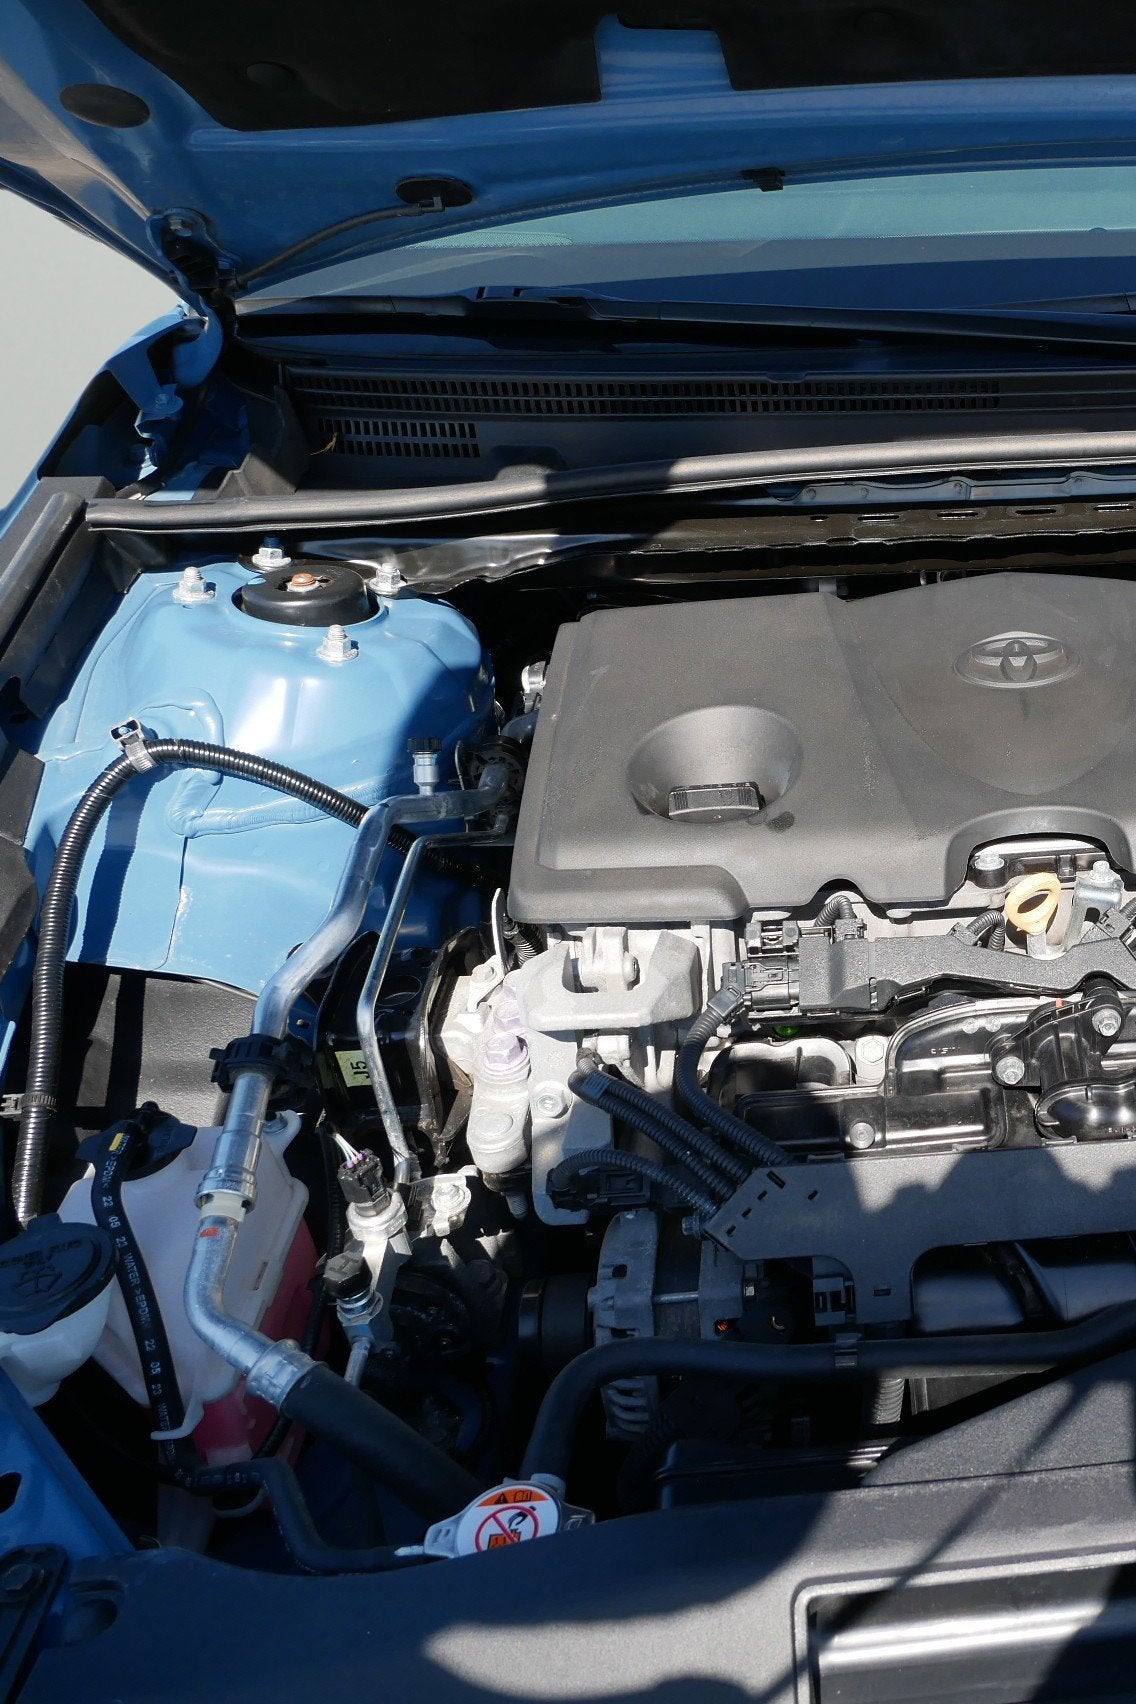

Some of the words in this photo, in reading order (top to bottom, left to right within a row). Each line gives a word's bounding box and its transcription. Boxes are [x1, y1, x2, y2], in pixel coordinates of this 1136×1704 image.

[102, 1195, 114, 1208] 22
[108, 1216, 121, 1229] 05
[115, 1236, 128, 1249] 23
[122, 1252, 141, 1287] WATER
[145, 1339, 156, 1352] 22
[150, 1361, 161, 1376] 05
